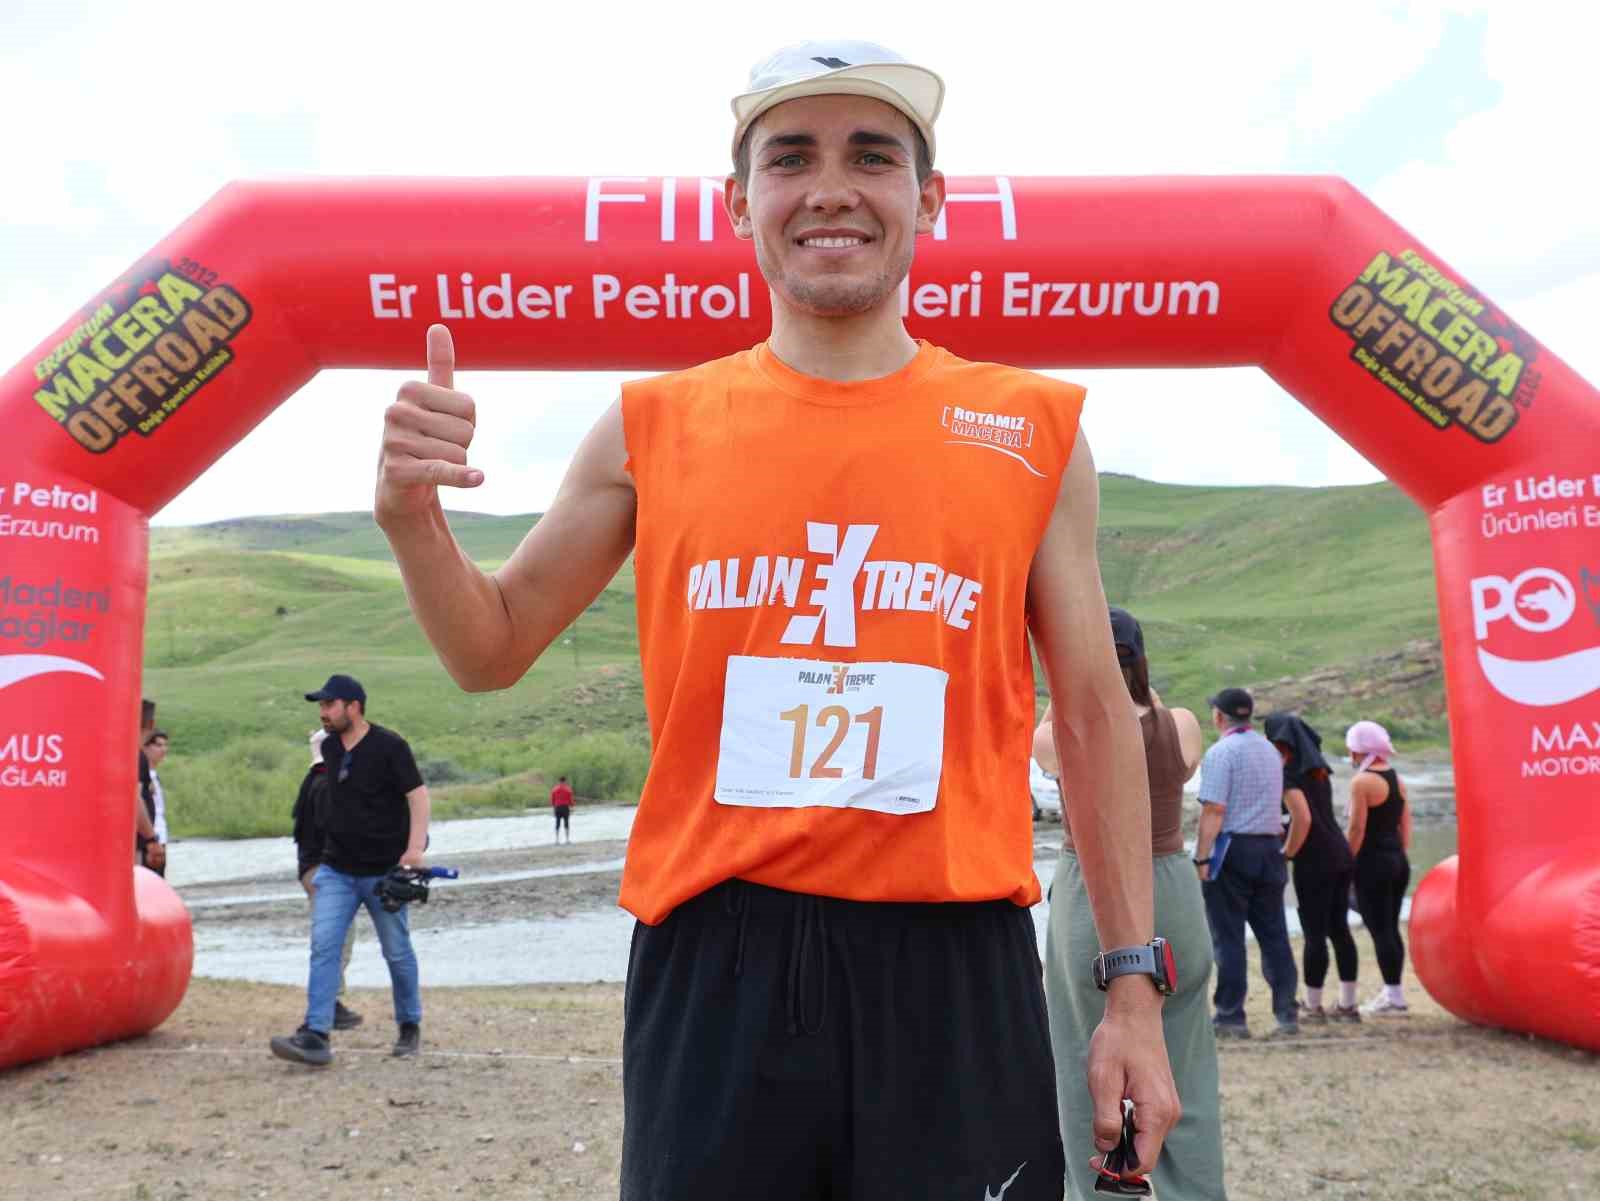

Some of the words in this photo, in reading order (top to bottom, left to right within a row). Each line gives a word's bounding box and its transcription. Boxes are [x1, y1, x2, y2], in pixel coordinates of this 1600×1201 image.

[369, 273, 417, 318] Er
[436, 272, 573, 319] Lider
[592, 273, 750, 319] Petrol
[899, 271, 983, 317] leri
[1003, 271, 1220, 317] Erzurum
[1359, 252, 1524, 396] MACERA
[34, 272, 204, 423] MACERA
[68, 286, 248, 451] OFFROAD
[1332, 284, 1516, 439] OFFROAD
[951, 420, 1021, 448] MACERA
[953, 407, 1026, 430] ROTAMIZ
[13, 482, 97, 513] Petrol
[1482, 484, 1507, 508] Er
[1514, 475, 1586, 502] Lider
[1482, 507, 1577, 538] Ürünleri
[687, 555, 805, 612] PALAN
[0, 610, 97, 649] ağlar
[779, 703, 884, 781] 121
[0, 765, 67, 787] ĞLARI
